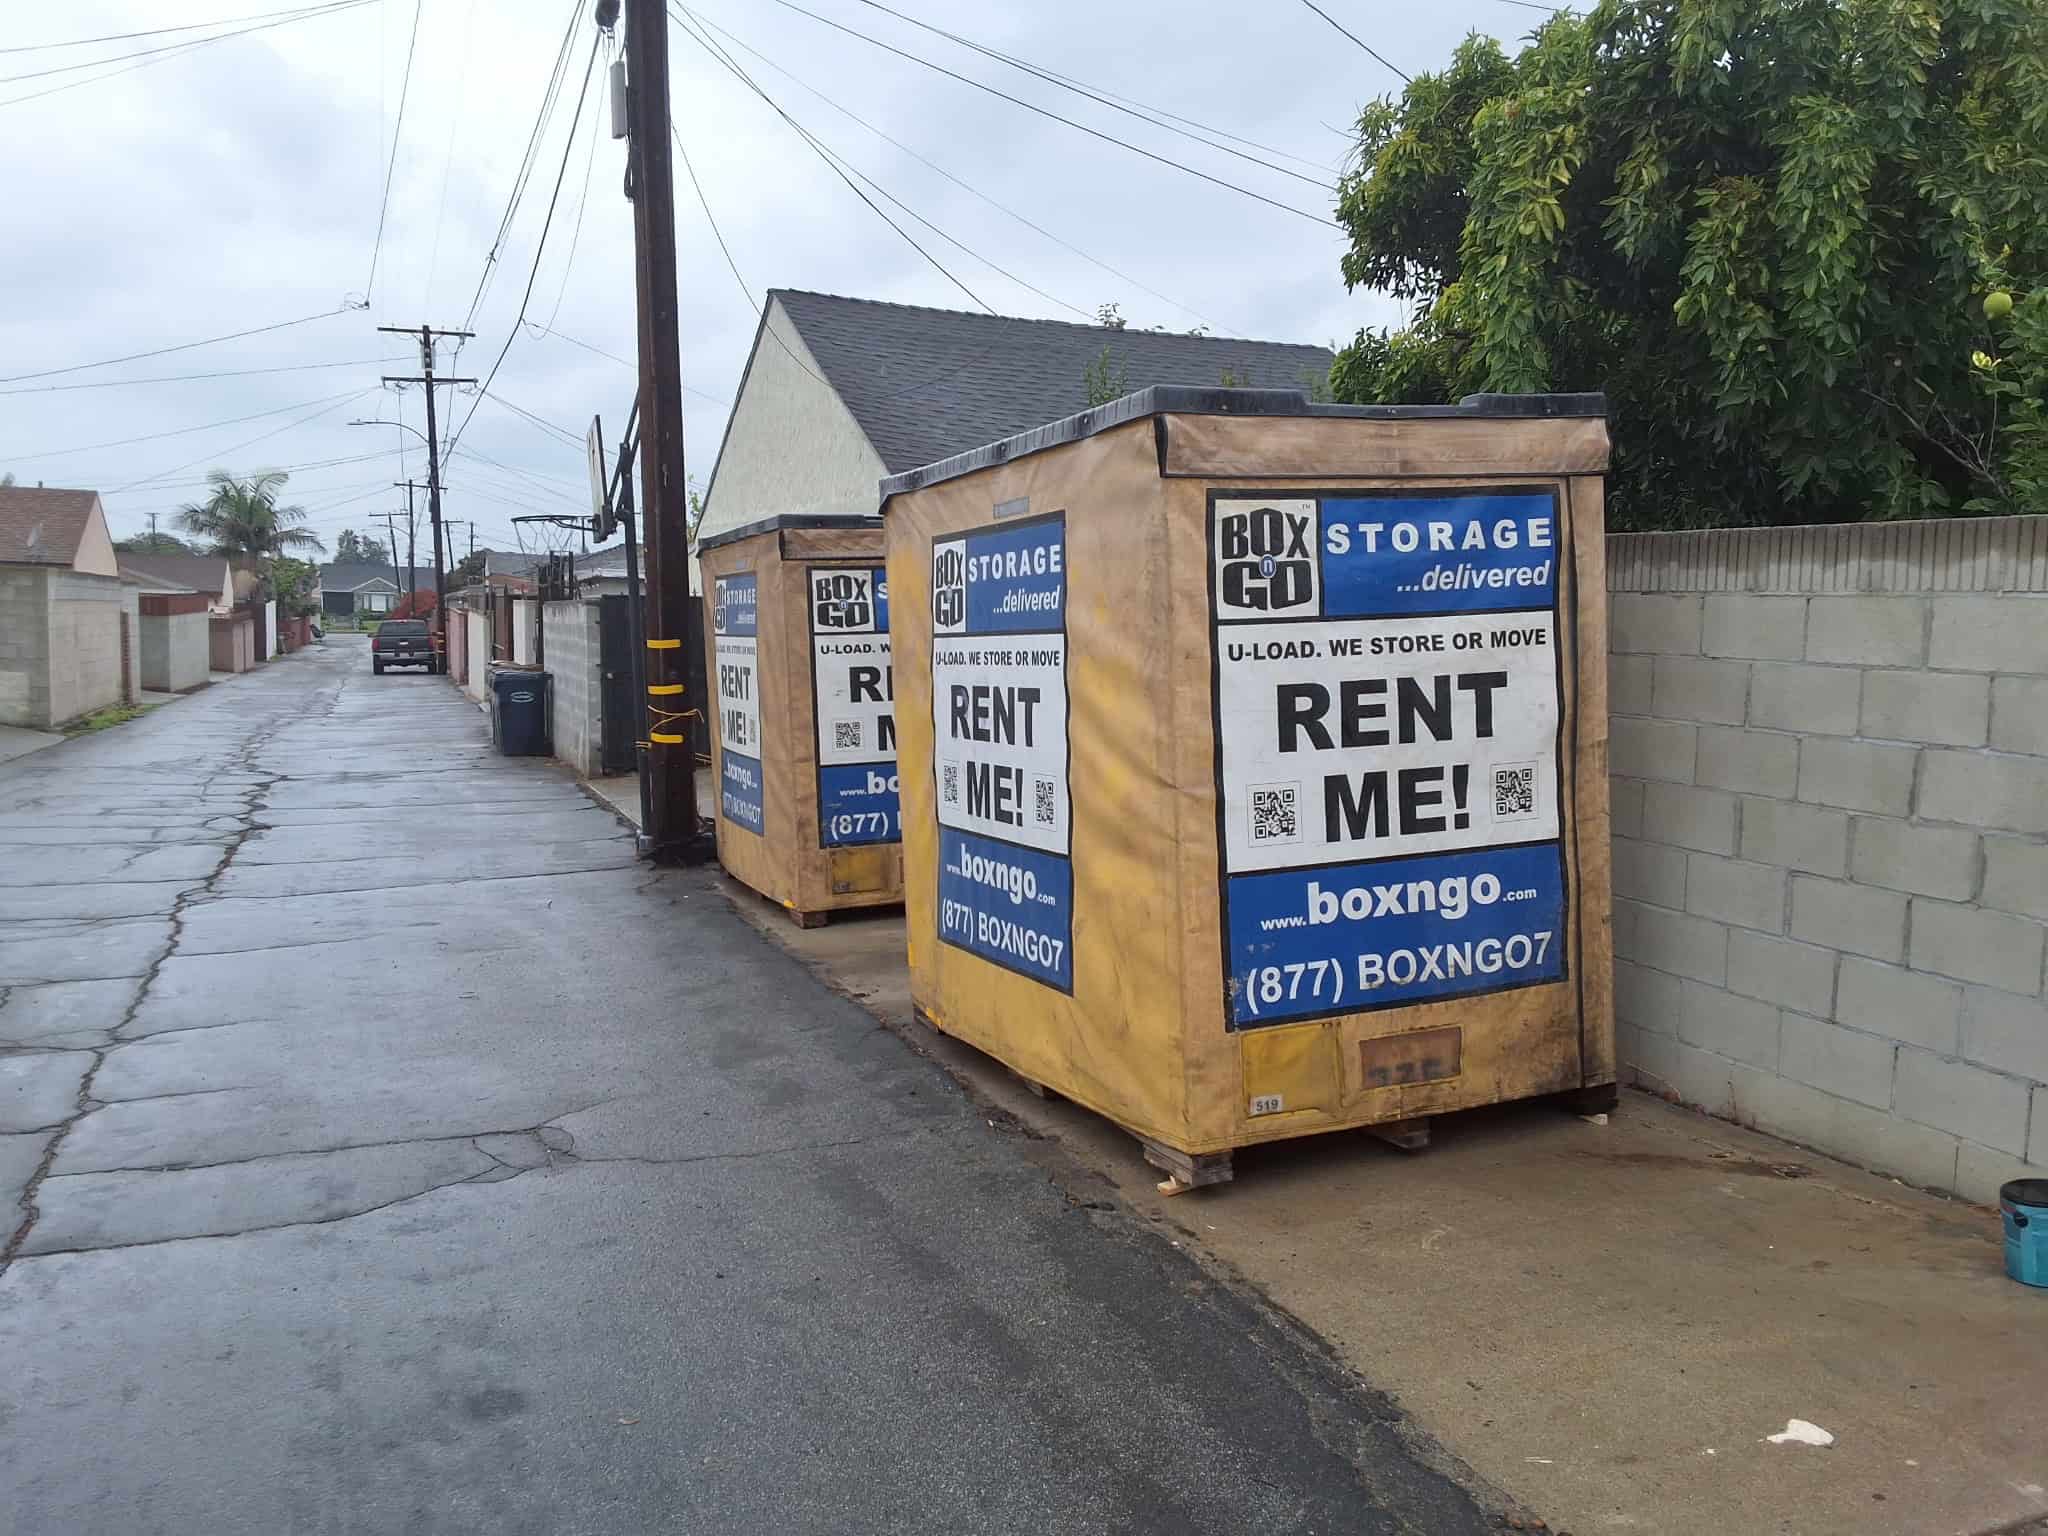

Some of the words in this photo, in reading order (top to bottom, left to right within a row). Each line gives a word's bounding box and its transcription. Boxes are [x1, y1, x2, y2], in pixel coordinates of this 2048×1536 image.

[1222, 508, 1310, 559] BOX
[1326, 518, 1552, 554] STORAGE
[936, 549, 964, 589] BOX
[969, 544, 1061, 582] STORAGE
[1397, 560, 1550, 592] ...delivered
[816, 575, 868, 601] BOX
[994, 585, 1060, 614] ...delivered
[1223, 560, 1312, 611] GO
[818, 602, 870, 628] GO
[936, 588, 963, 628] GO
[969, 652, 981, 665] WE
[984, 651, 1012, 665] STORE
[1015, 651, 1028, 665] OR
[1031, 650, 1060, 666] MOVE
[1228, 639, 1322, 661] U-LOAD.
[1329, 638, 1362, 657] WE
[1370, 634, 1444, 654] STORE
[1452, 632, 1483, 650] OR
[1490, 628, 1546, 649] MOVE
[721, 664, 751, 700] RENT
[728, 710, 747, 745] ME!
[951, 685, 1040, 747] RENT
[1276, 671, 1508, 753] RENT
[967, 760, 1023, 827] ME!
[1324, 764, 1470, 842] ME!
[831, 812, 889, 840] (877)
[1260, 873, 1537, 931] www.boxngo.com
[942, 897, 974, 944] (877)
[978, 911, 1063, 972] BOXNGO7
[1246, 957, 1344, 1014] (877)
[1358, 931, 1552, 991] BOXNGO7
[1255, 1099, 1279, 1112] 519
